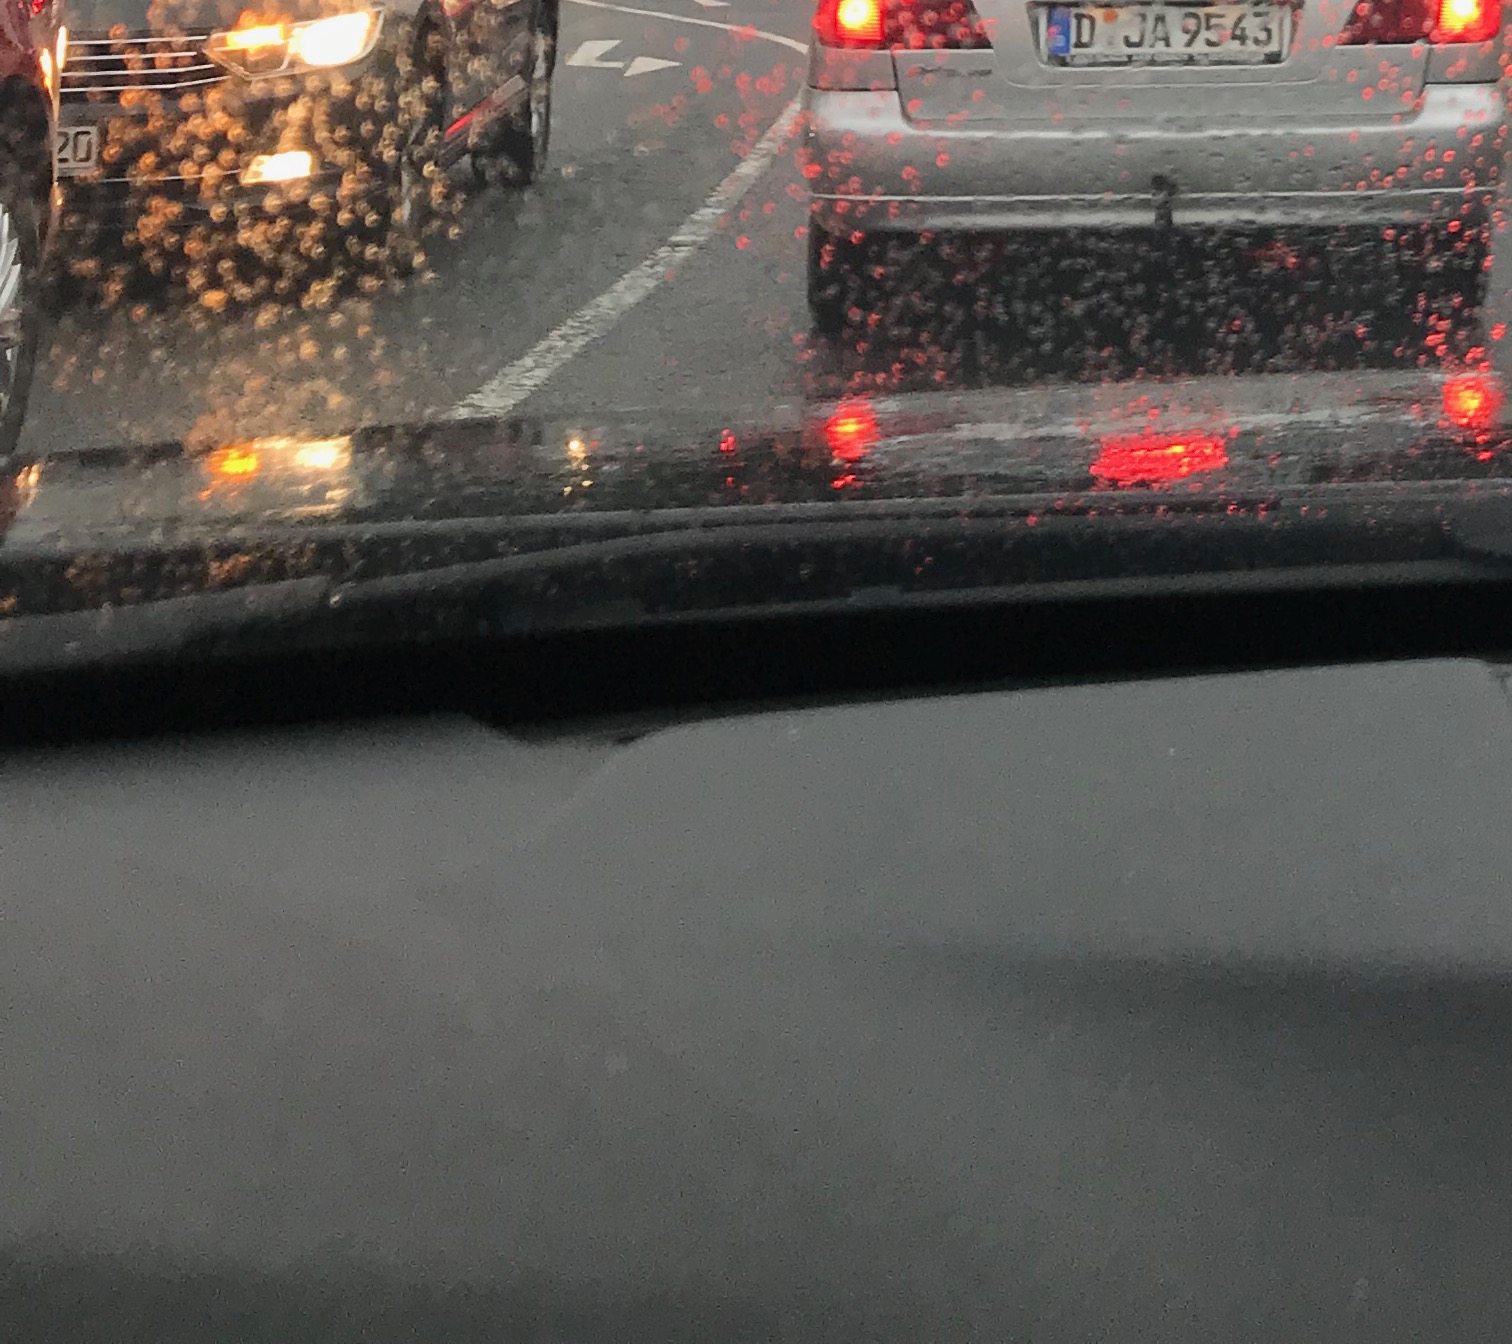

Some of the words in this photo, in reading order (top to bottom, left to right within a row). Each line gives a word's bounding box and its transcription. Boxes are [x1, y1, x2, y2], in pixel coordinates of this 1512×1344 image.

[1073, 12, 1096, 48] D
[1123, 12, 1171, 48] JA
[1181, 11, 1273, 48] 9543
